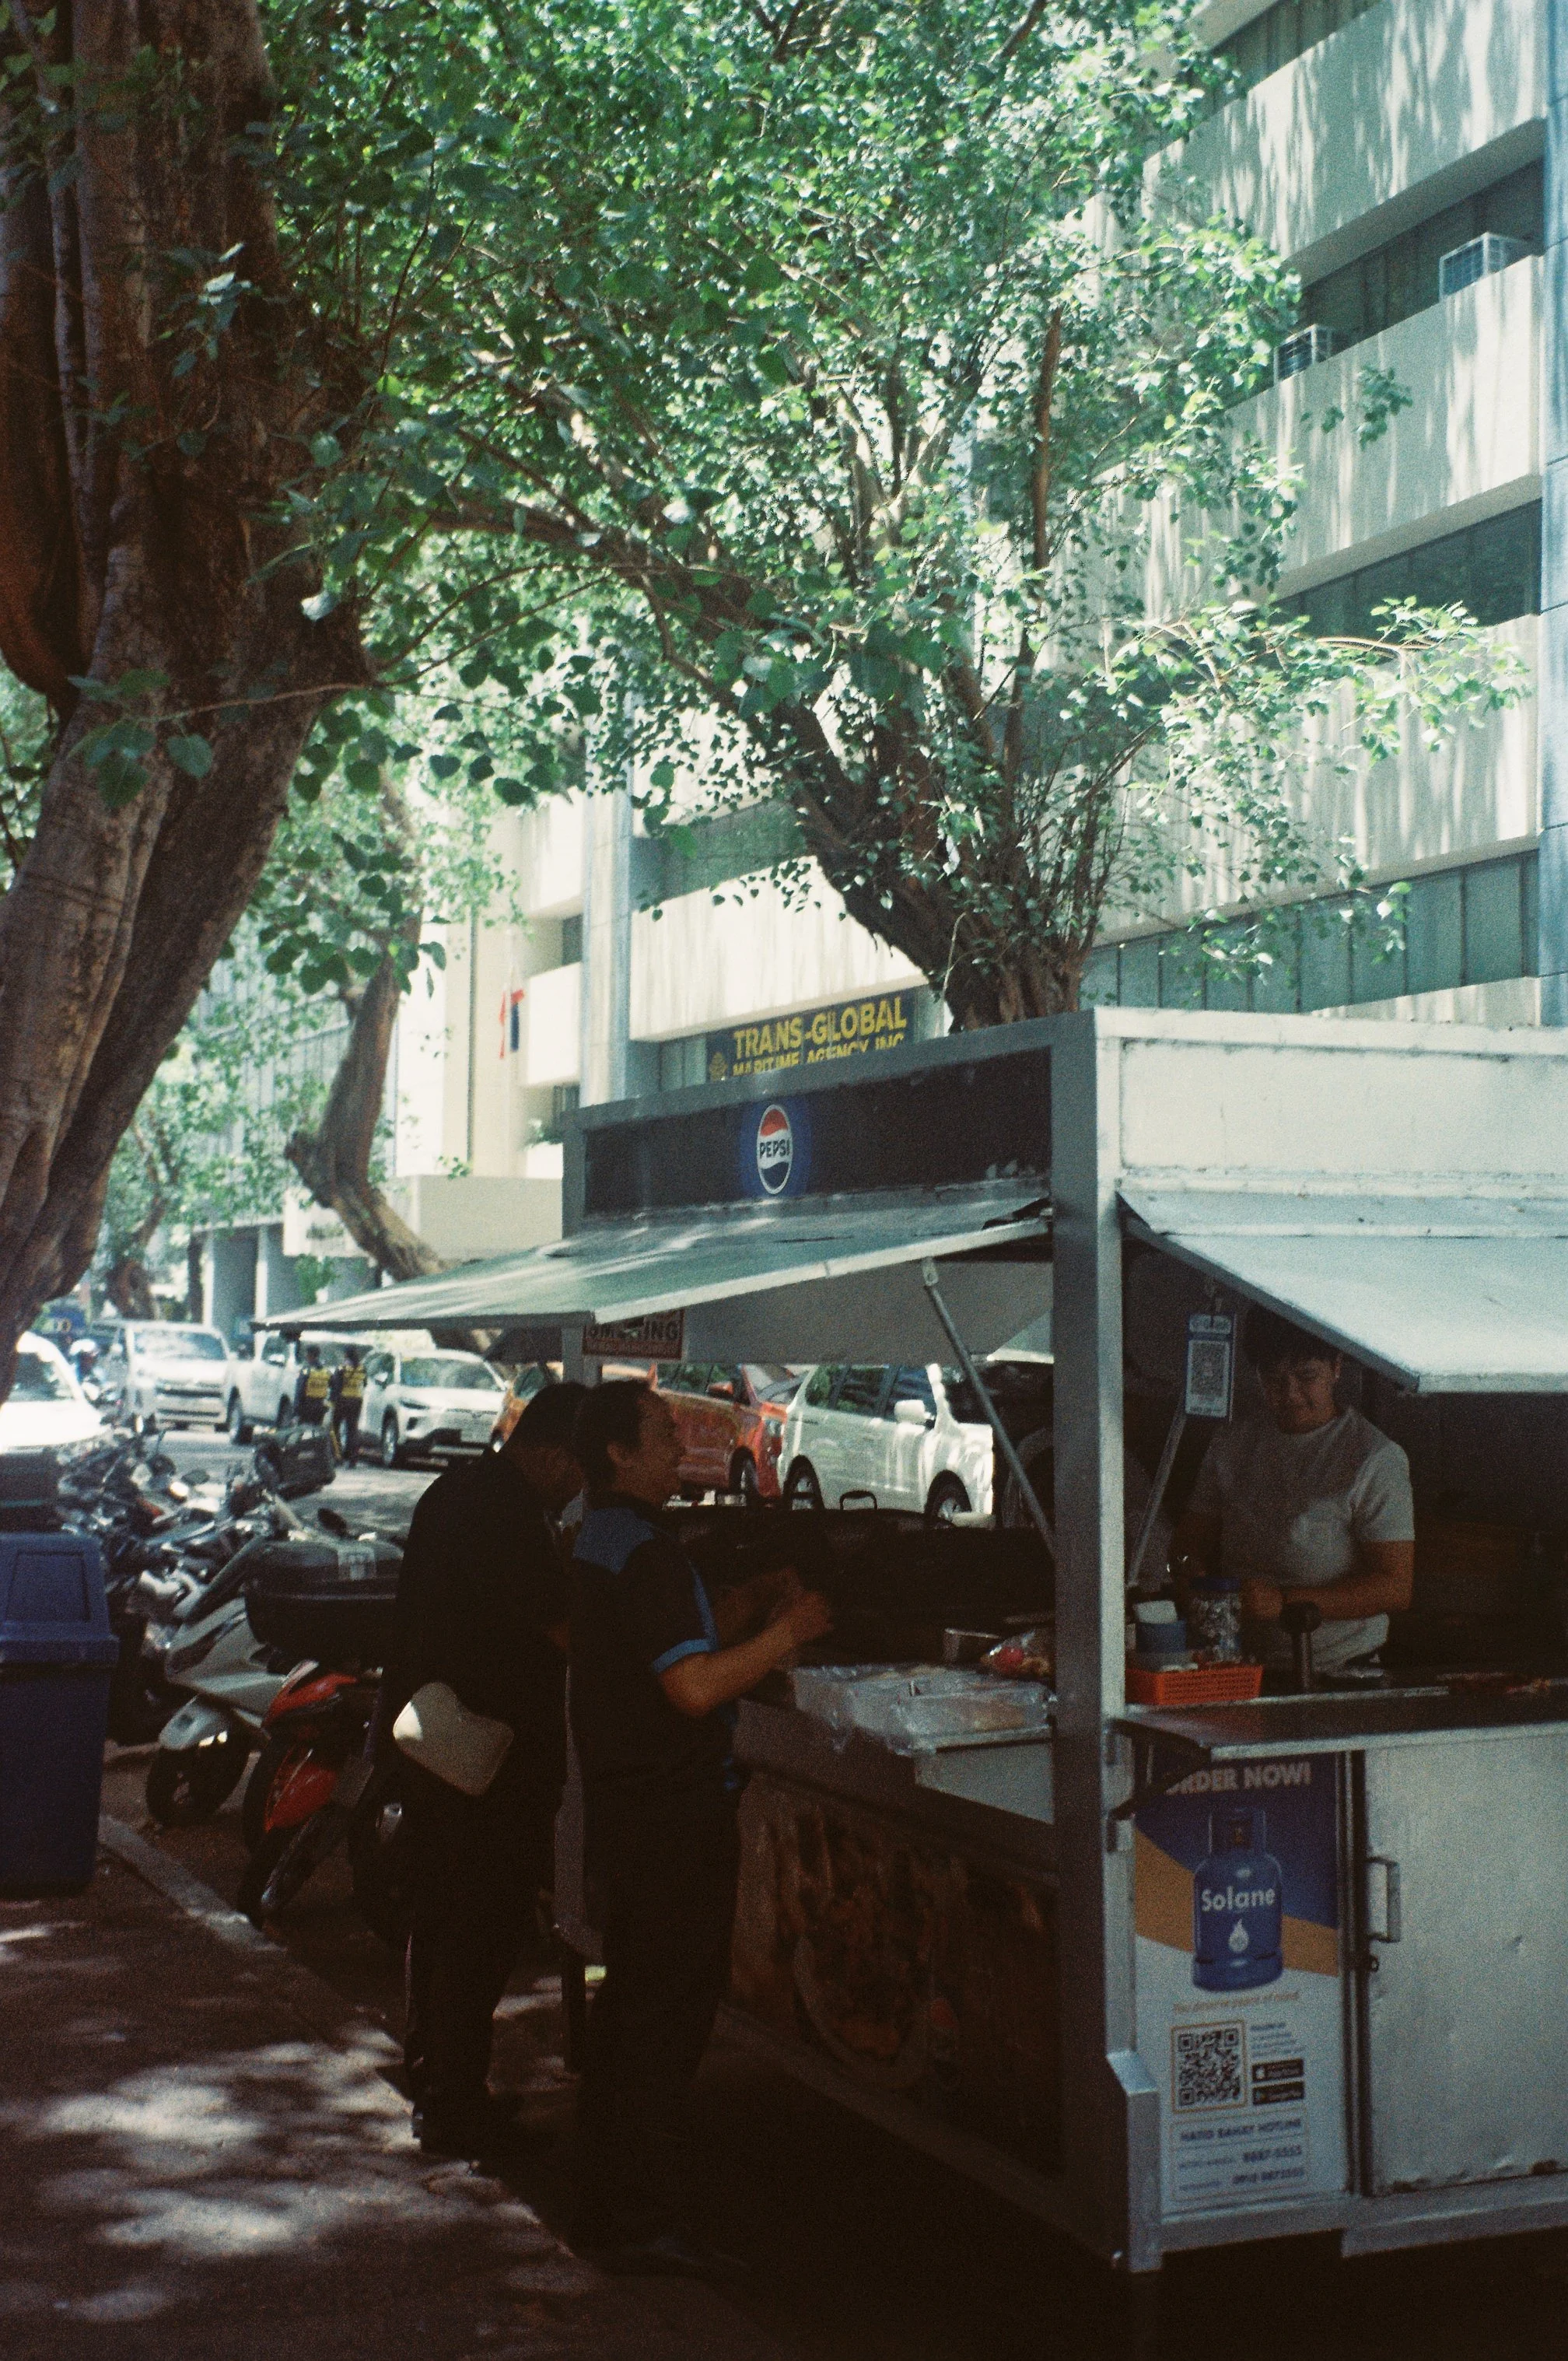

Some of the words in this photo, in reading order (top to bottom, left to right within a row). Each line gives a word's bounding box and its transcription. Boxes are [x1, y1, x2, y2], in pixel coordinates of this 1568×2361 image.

[733, 996, 907, 1060] TRANS-GLOBAL
[733, 1053, 800, 1076] MARITIME
[759, 1139, 790, 1159] PEPSI
[1244, 1760, 1312, 1789] NOW!
[1202, 1886, 1275, 1912] Solane
